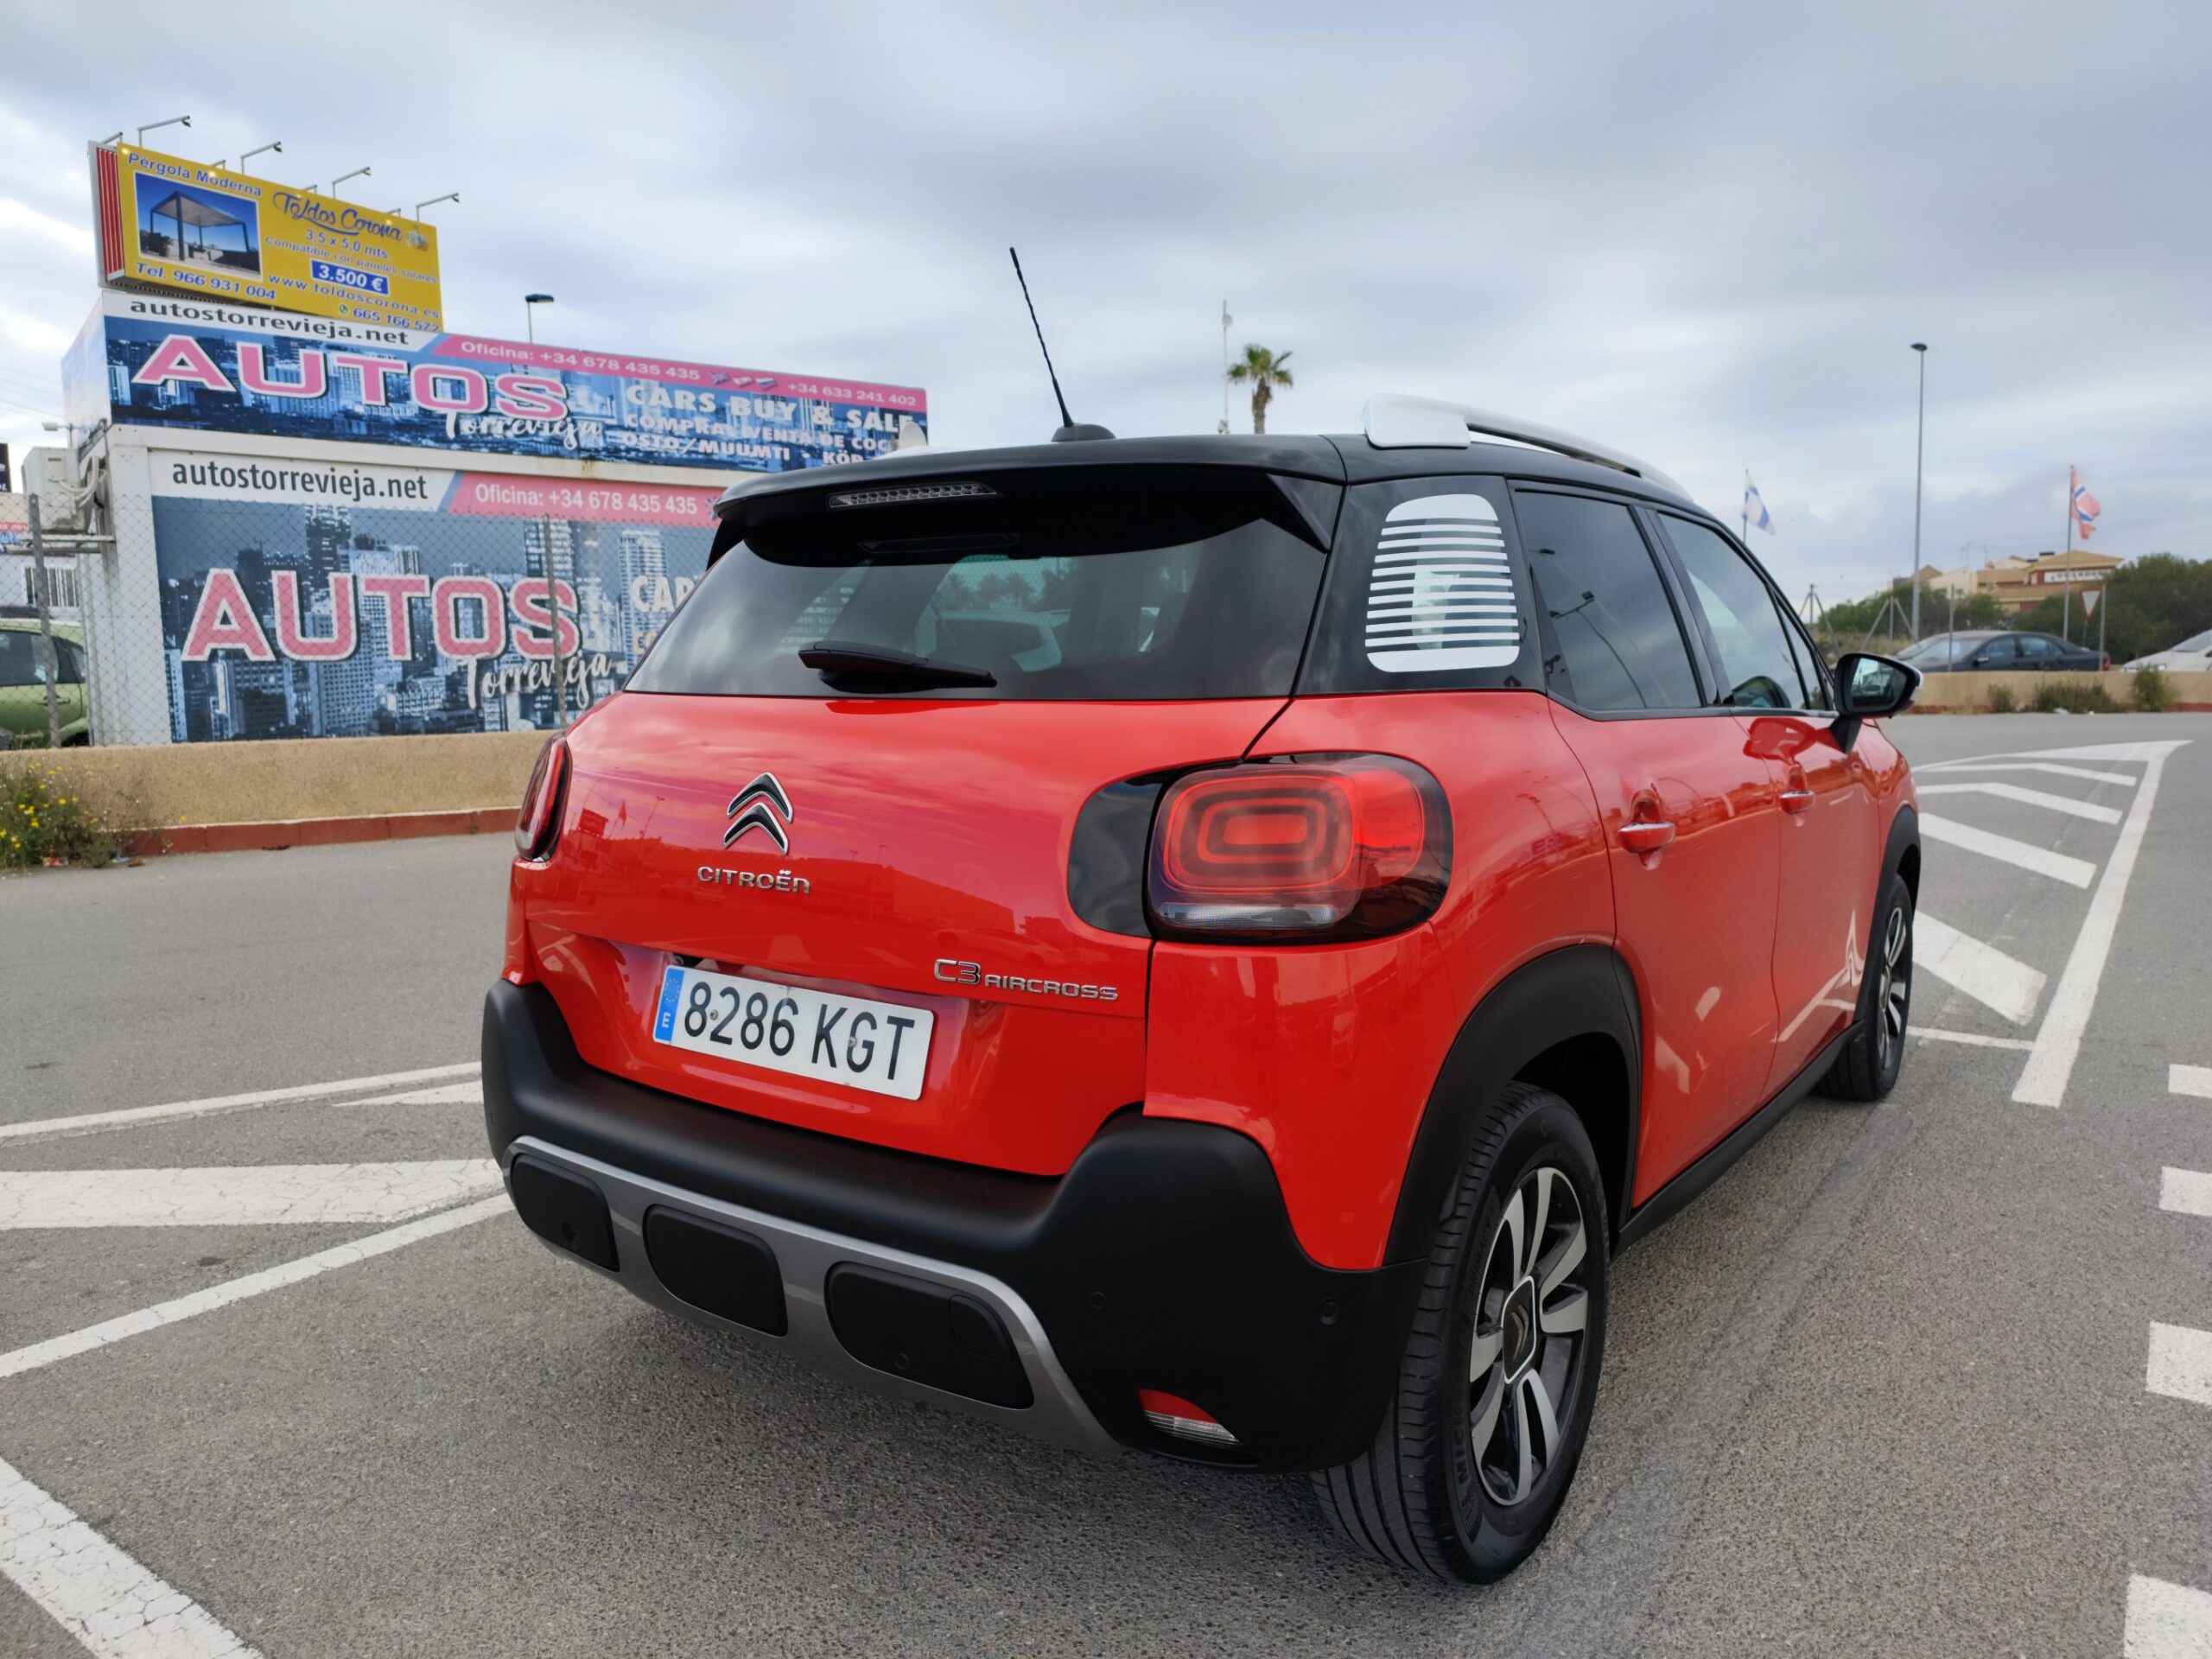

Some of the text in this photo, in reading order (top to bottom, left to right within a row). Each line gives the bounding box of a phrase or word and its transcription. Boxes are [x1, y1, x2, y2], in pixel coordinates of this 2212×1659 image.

[128, 151, 262, 197] Pérgola Moderna
[273, 192, 403, 243] Toldos Corona
[265, 234, 331, 258] Compatible
[334, 252, 354, 264] con
[400, 268, 437, 284] solares
[318, 264, 384, 292] 3.500 €
[135, 261, 276, 300] Tel. 966 931 004
[130, 299, 410, 346] autostorrevieja.net
[353, 306, 440, 334] 665 166 572
[131, 334, 570, 422] AUTOS
[461, 340, 701, 382] Oficina: +34 678 435 435
[625, 384, 717, 413] CARS
[730, 394, 798, 422] BUY
[811, 404, 835, 426] &
[787, 381, 918, 407] +34 633 241 402
[445, 410, 603, 450] Torrevieja
[818, 432, 845, 448] DE
[172, 461, 429, 502] autostorrevieja.net
[475, 482, 697, 515] Oficina: +34 678 435 435
[180, 566, 582, 662] AUTOS
[456, 650, 613, 709] Torreveja
[933, 957, 1119, 1001] C3 AIRCROSS
[661, 1011, 671, 1029] E
[683, 980, 916, 1081] 8286 KGT
